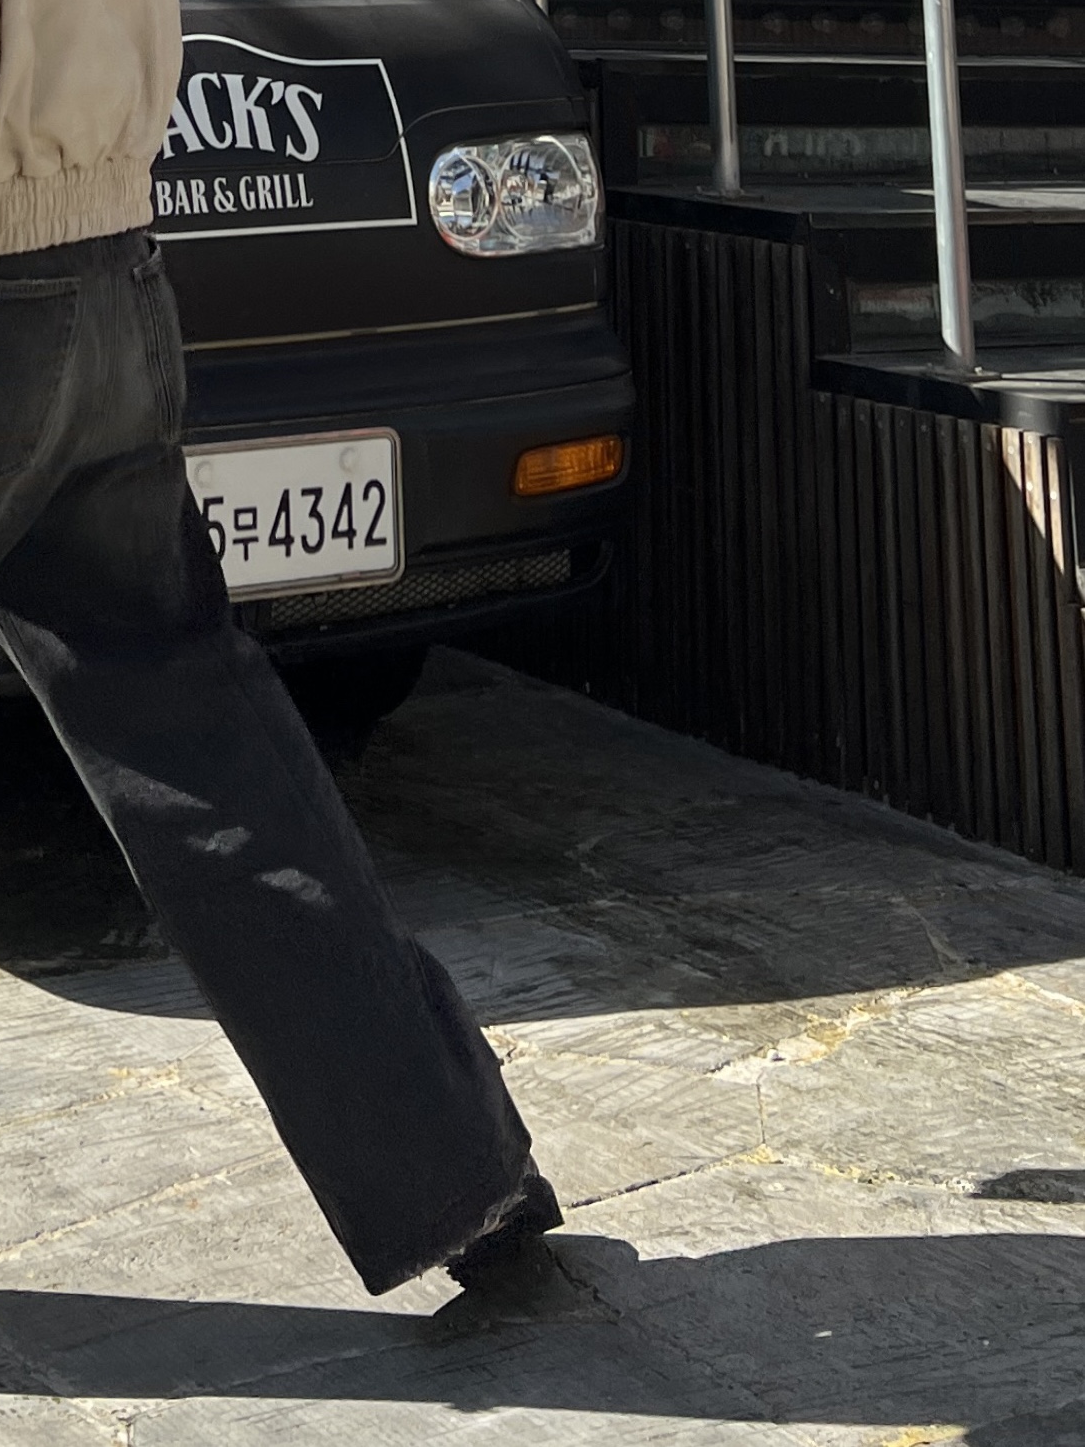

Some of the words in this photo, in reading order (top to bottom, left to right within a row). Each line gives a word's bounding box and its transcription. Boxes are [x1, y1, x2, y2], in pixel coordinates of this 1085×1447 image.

[162, 72, 323, 163] ACK'S
[154, 179, 209, 217] BAR
[213, 176, 238, 213] &
[238, 173, 314, 211] GRILL
